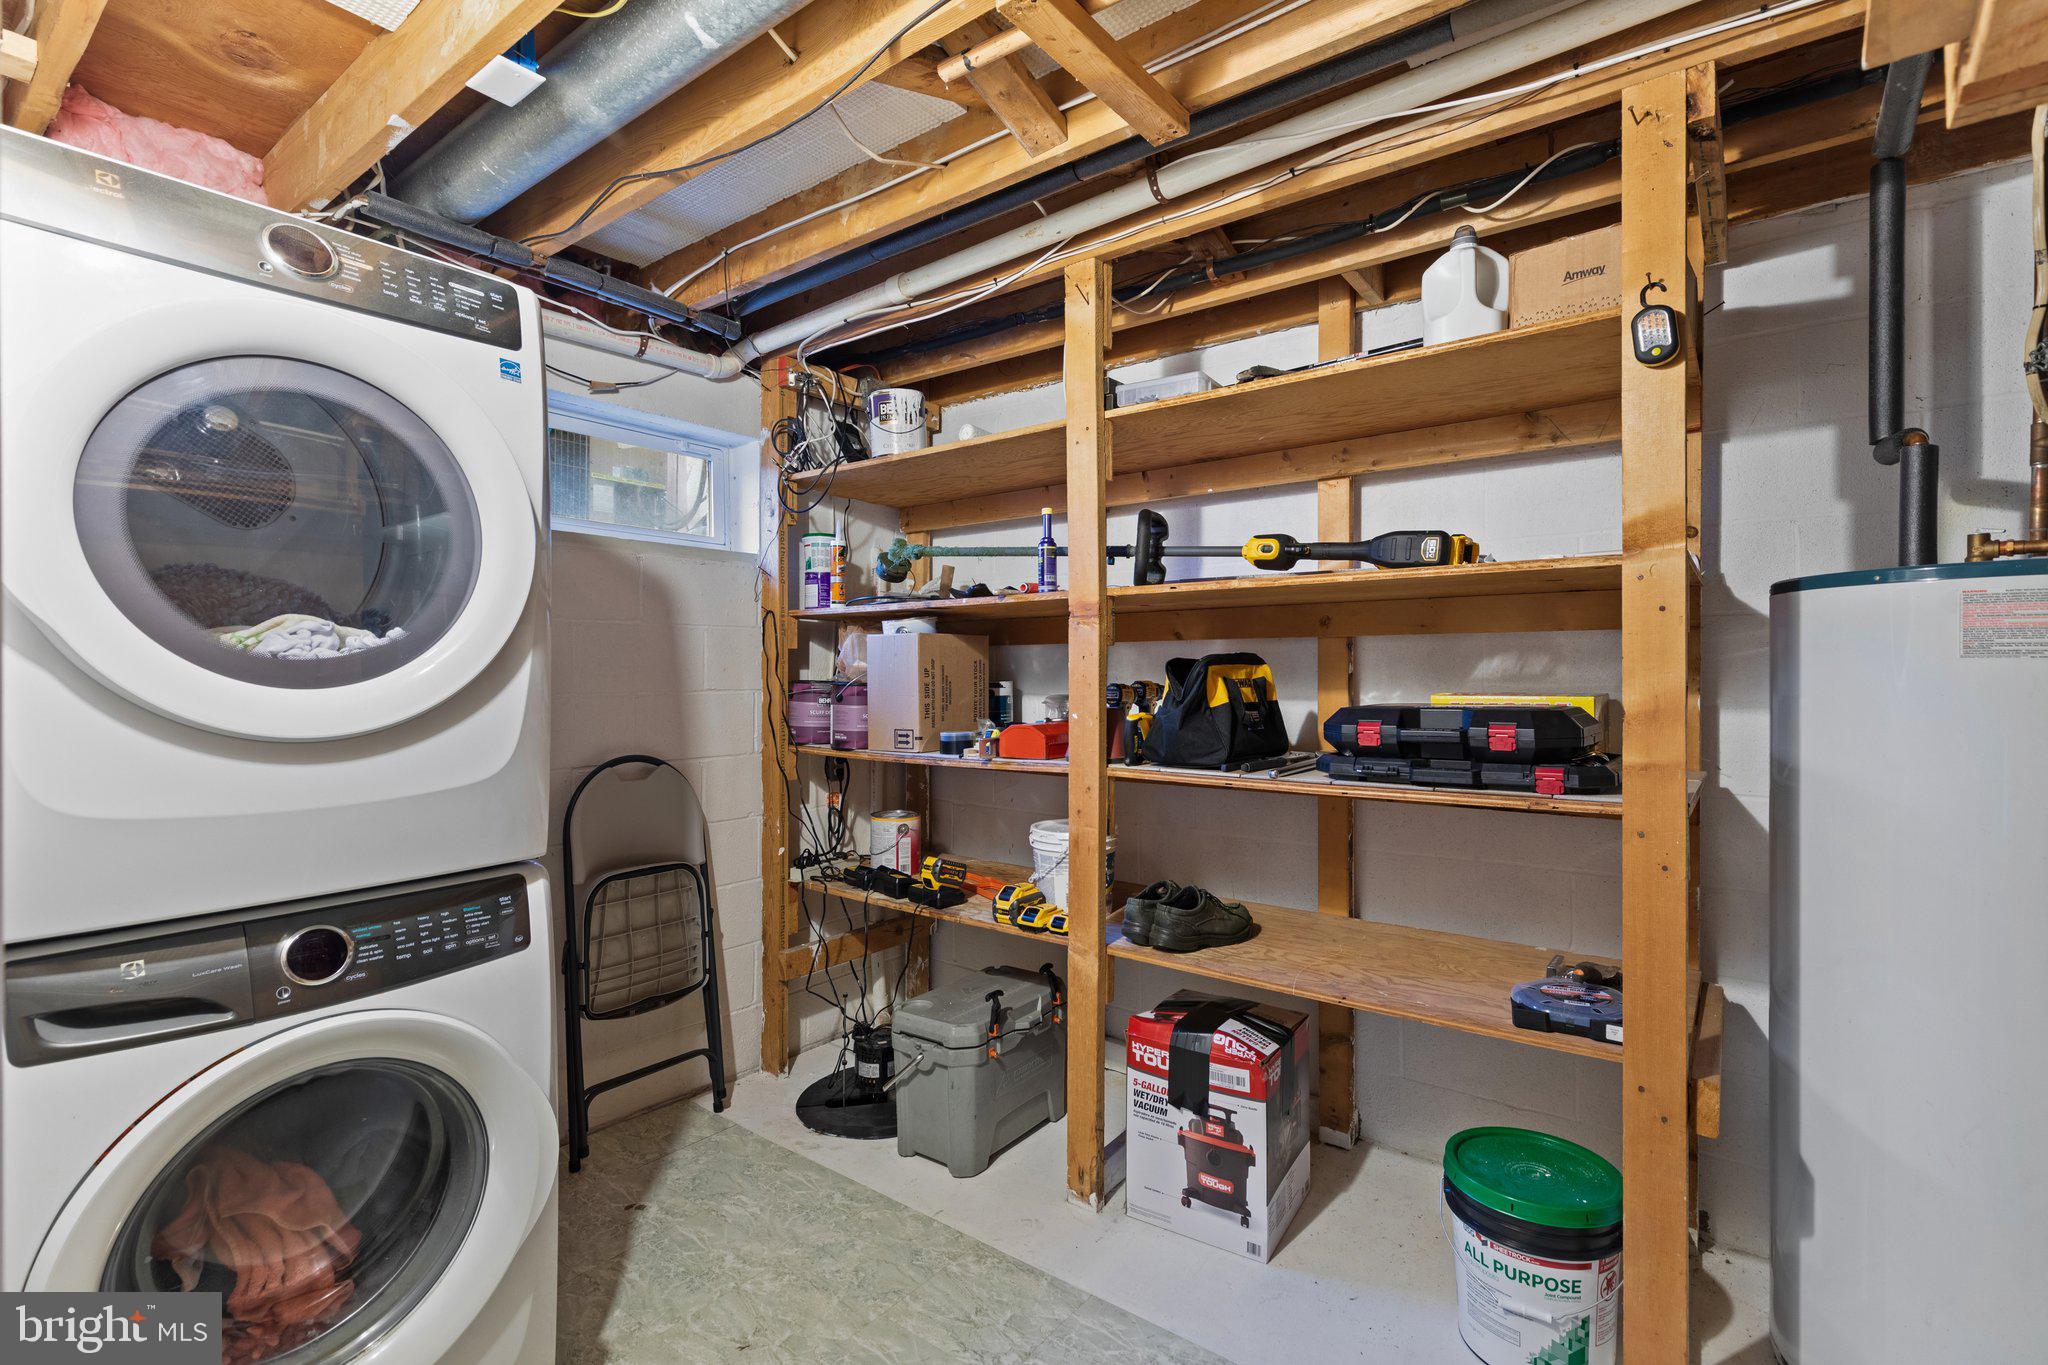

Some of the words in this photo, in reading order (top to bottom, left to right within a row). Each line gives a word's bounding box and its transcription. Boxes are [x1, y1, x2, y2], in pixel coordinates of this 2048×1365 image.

[1563, 265, 1606, 282] Amway
[924, 667, 930, 678] UP
[466, 937, 485, 945] options
[192, 967, 222, 978] LuxCare
[224, 963, 243, 972] Wash
[345, 972, 366, 982] cycles
[1132, 1040, 1169, 1059] HYPER
[1132, 1050, 1169, 1071] TOU
[1133, 1078, 1169, 1096] 5-GALLO
[1133, 1099, 1168, 1117] VACUUM
[1201, 1178, 1231, 1192] TOUGH
[1493, 1243, 1532, 1263] SHEETROCK
[1464, 1241, 1489, 1269] ALL
[1493, 1259, 1582, 1294] PURPOSE
